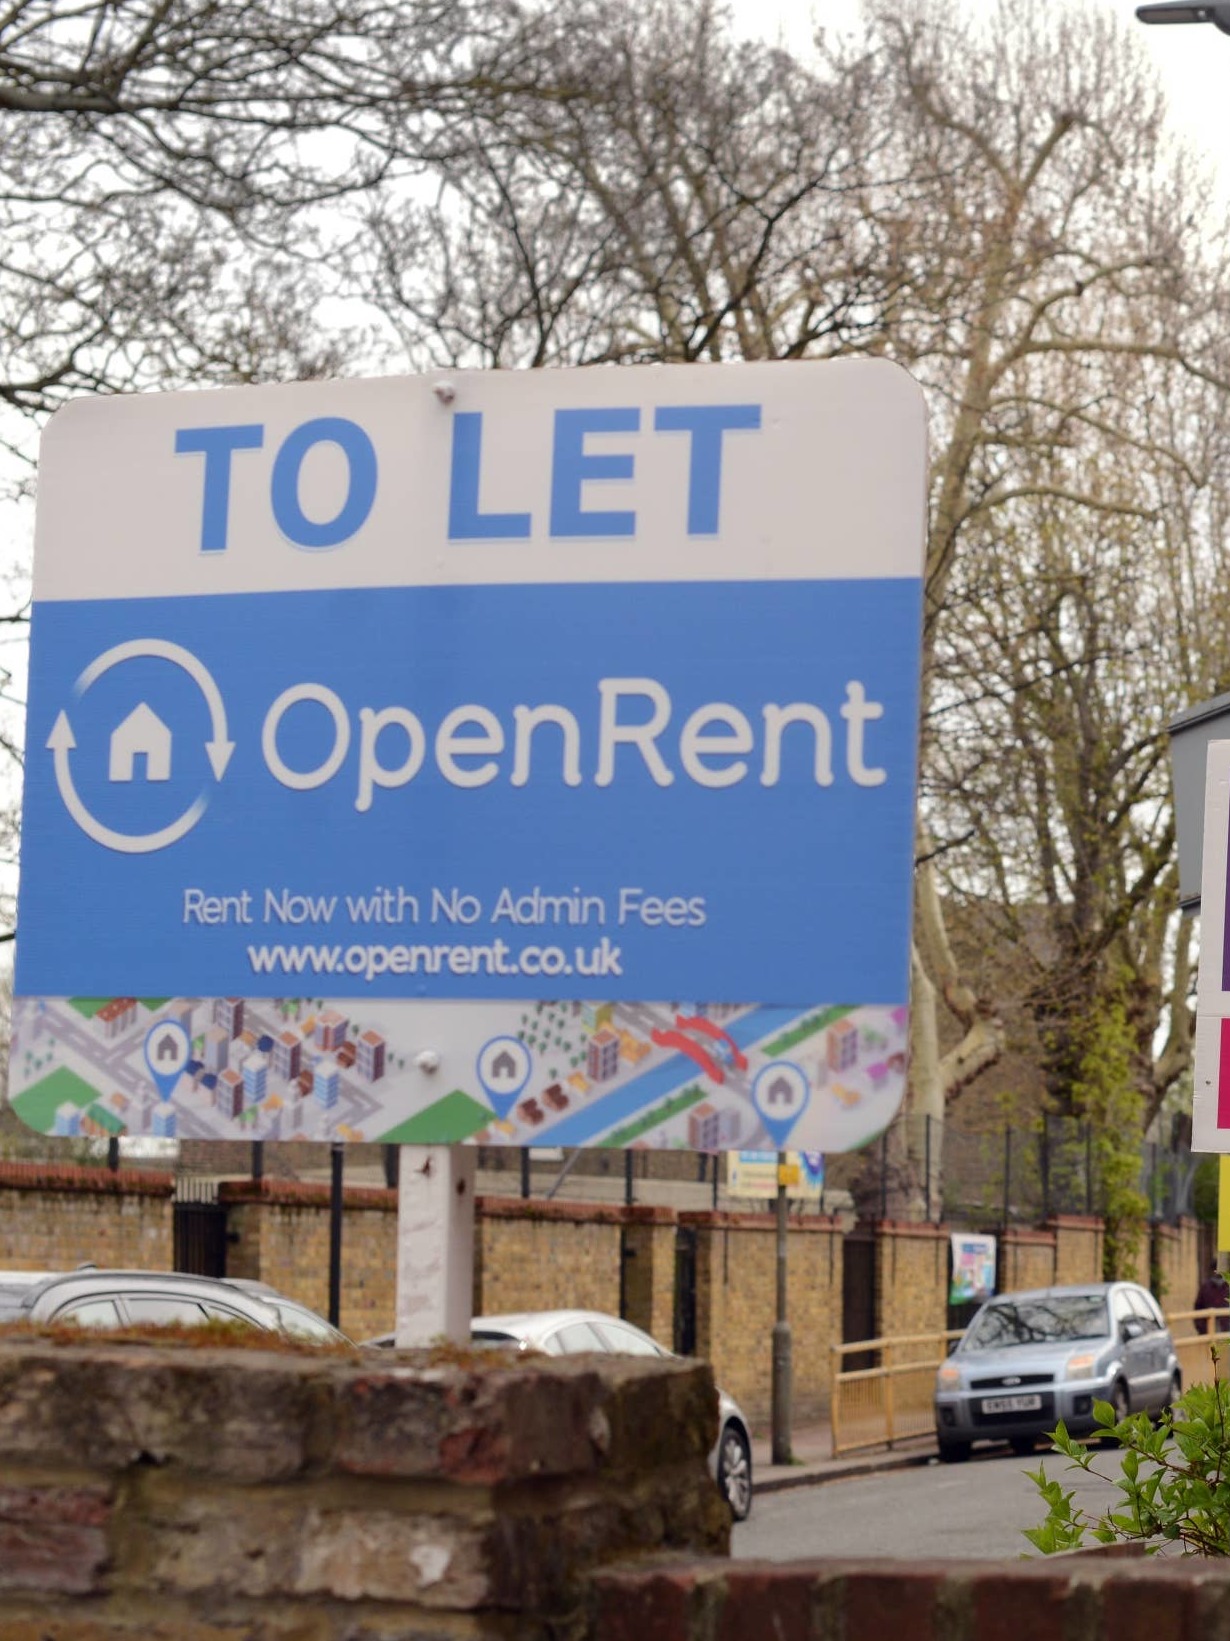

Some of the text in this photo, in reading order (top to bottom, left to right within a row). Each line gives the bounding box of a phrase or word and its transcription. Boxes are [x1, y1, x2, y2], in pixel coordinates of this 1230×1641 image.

[175, 404, 761, 551] TO LET
[262, 678, 887, 812] OpenRent
[183, 886, 707, 926] Rent Now with No Admin Fees
[248, 936, 623, 981] www.openrent.co.uk
